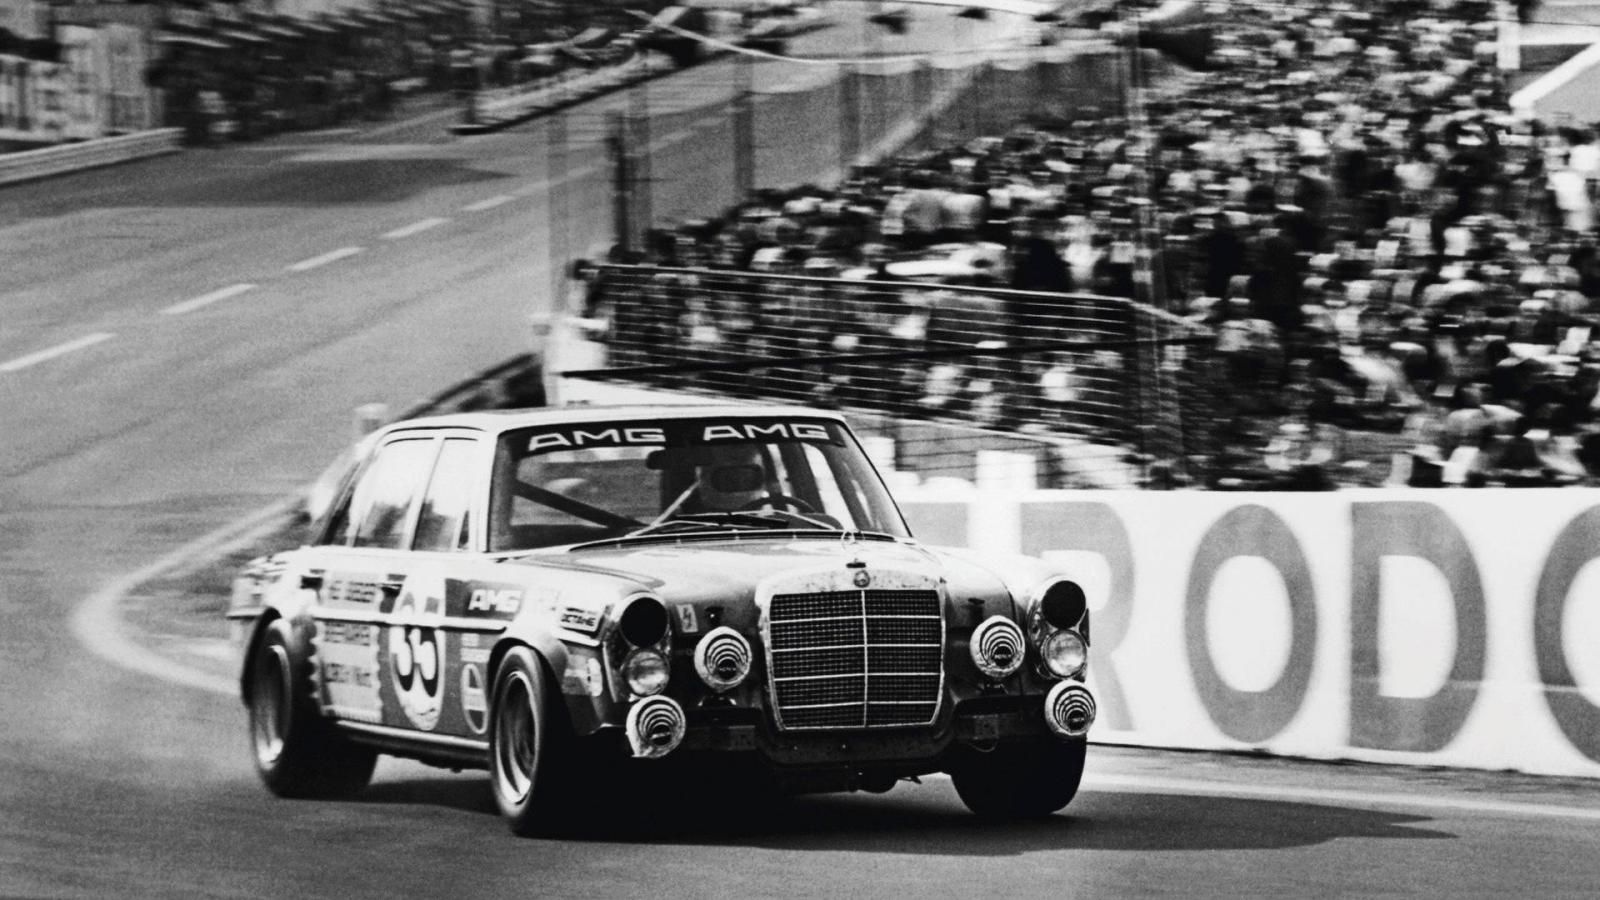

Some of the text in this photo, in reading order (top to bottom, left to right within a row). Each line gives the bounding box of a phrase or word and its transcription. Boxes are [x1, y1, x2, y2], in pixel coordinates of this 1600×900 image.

[528, 422, 830, 451] AMG AMG
[468, 588, 522, 613] AMG
[392, 590, 439, 698] 35
